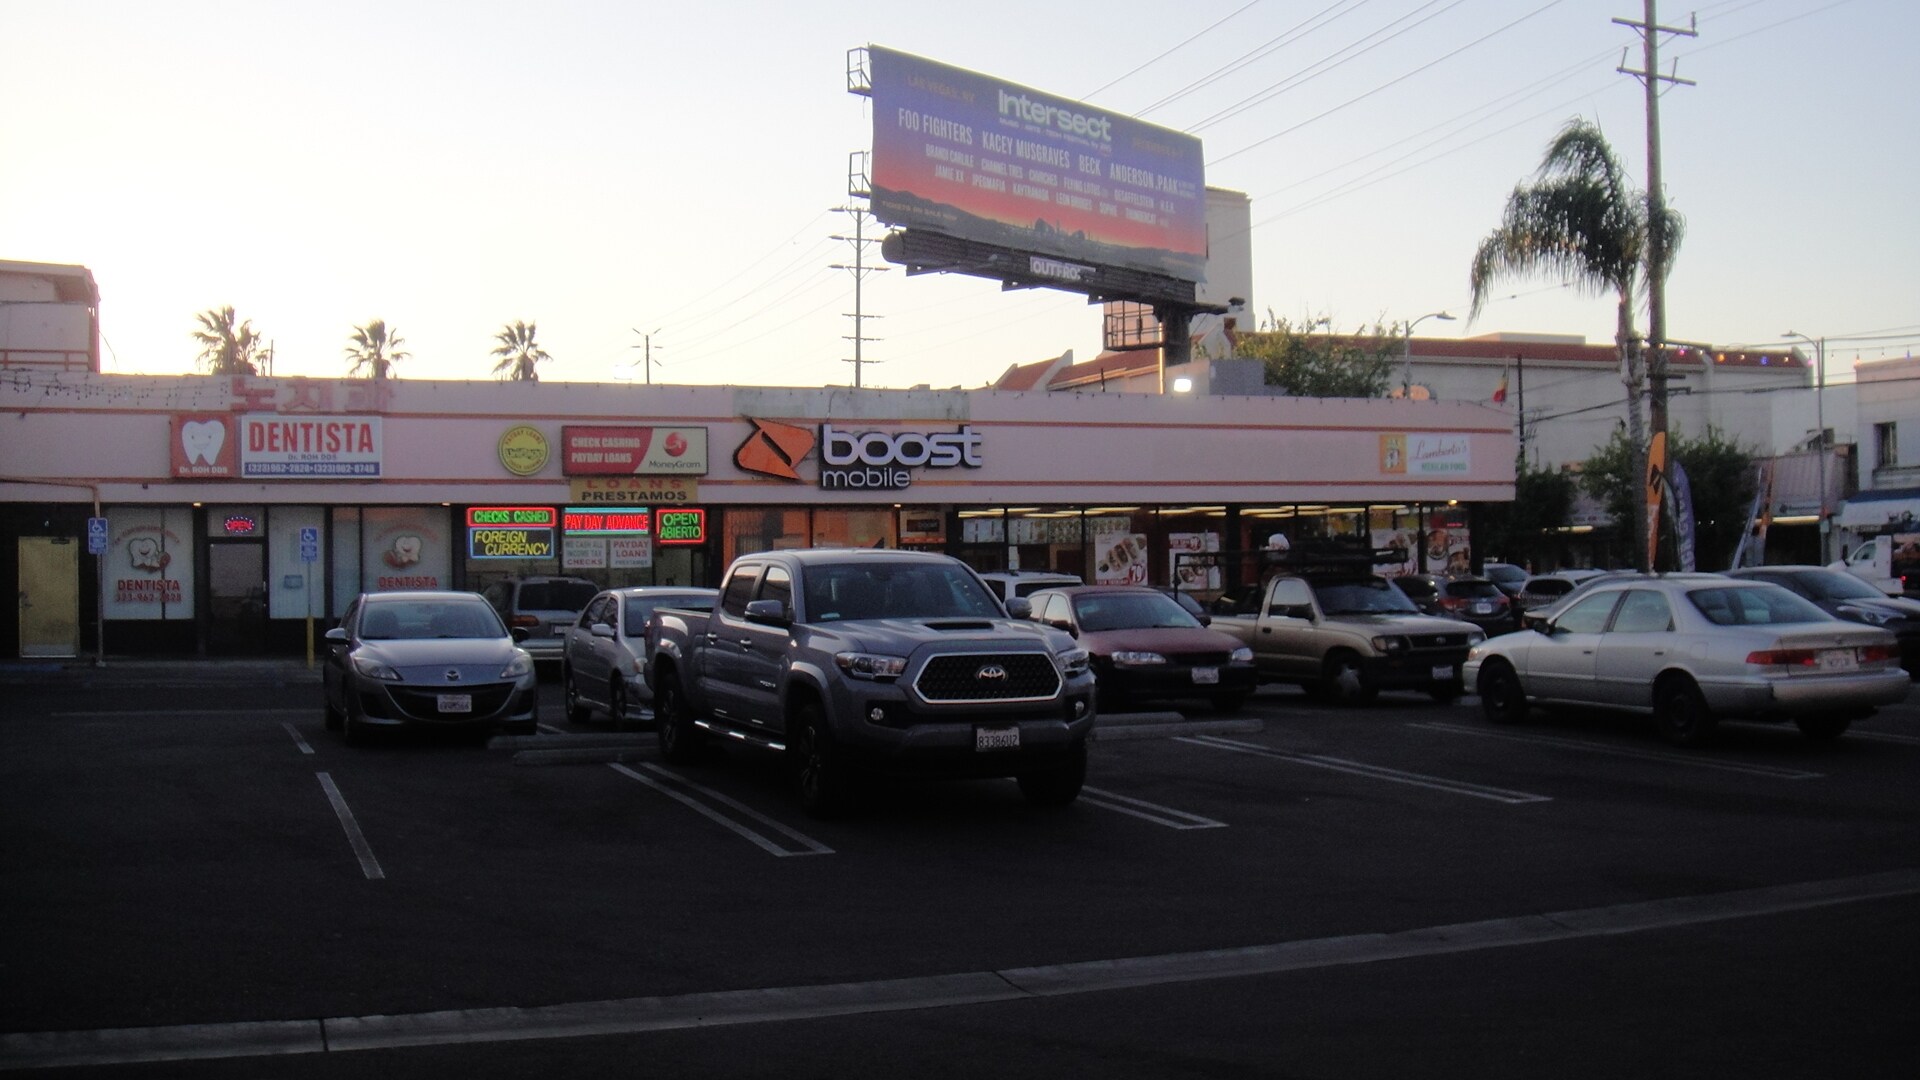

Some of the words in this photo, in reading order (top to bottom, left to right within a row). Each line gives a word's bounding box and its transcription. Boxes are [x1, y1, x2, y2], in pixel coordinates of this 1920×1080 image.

[998, 89, 1112, 141] Intersect
[899, 107, 920, 131] FOO
[923, 114, 973, 145] FIGHTERS
[982, 130, 1013, 155] KACEY
[1016, 139, 1070, 169] MUSGRAVES
[1079, 154, 1102, 176] BECK
[1110, 162, 1154, 188] ANDERSON
[1032, 260, 1082, 280] OUTFRO
[248, 422, 375, 453] DENTISTA
[571, 436, 601, 448] CHECK
[602, 436, 641, 448] CASHING
[823, 423, 982, 466] boost
[571, 452, 603, 464] PAYDAY
[604, 452, 632, 464] LOANS
[649, 459, 701, 469] MoneyGram
[822, 467, 911, 487] mobile
[586, 479, 683, 489] LOANS
[581, 491, 688, 501] PRESTAMOS
[473, 510, 510, 523] CHECKS
[513, 510, 549, 523] CASHED
[564, 514, 582, 530] PAY
[584, 514, 602, 530] DAY
[606, 514, 648, 530] ADVANCE
[662, 513, 698, 526] OPEN
[226, 520, 252, 531] OPEN
[475, 530, 527, 543] FOREIGN
[659, 526, 701, 539] ABIERTO
[484, 543, 550, 556] CURRENCY
[616, 550, 648, 558] LOANS
[117, 579, 180, 591] DENTISTA
[377, 576, 438, 588] DENTISTA
